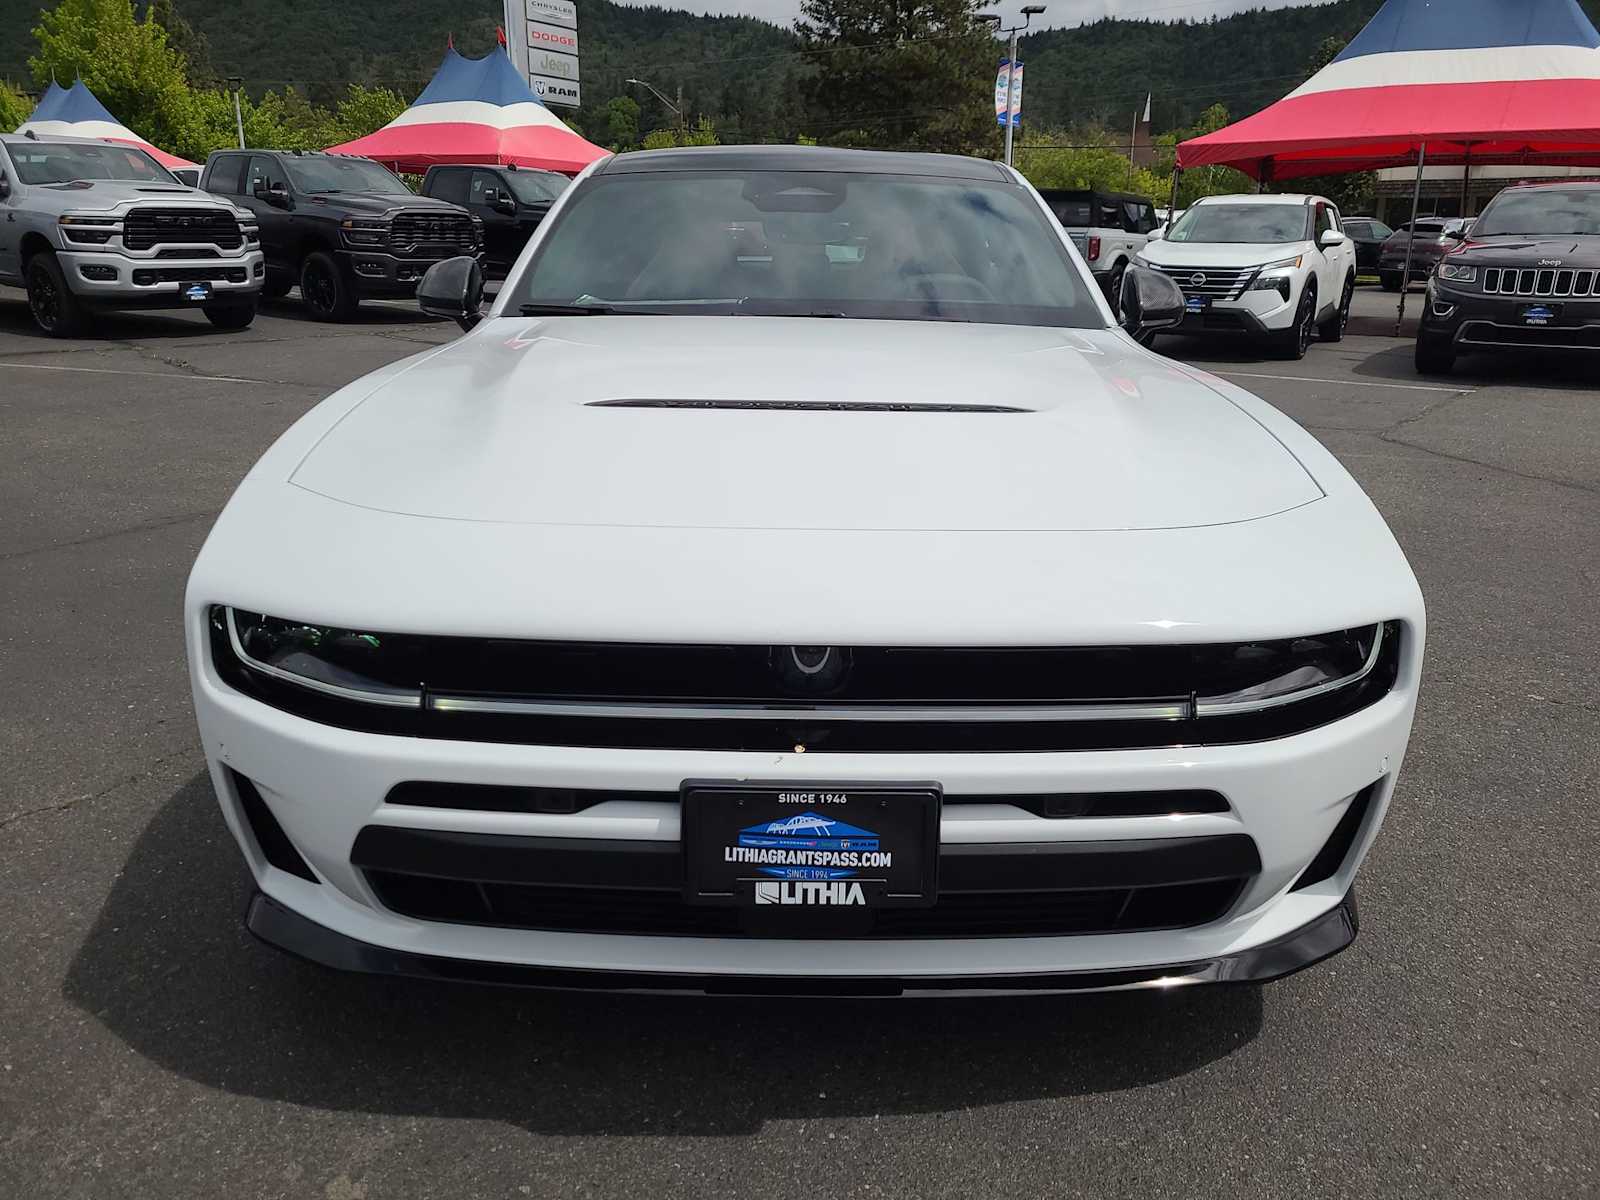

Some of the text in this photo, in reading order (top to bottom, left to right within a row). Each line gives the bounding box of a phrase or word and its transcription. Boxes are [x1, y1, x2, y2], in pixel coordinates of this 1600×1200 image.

[531, 1, 573, 14] CHRYSLER
[531, 31, 576, 46] DODGE
[540, 54, 570, 76] Jeep
[548, 86, 577, 97] RAM
[1537, 259, 1561, 267] Jeep
[778, 793, 847, 804] SINCE 1946
[724, 846, 892, 868] LITHIAGRANTSPASS.COM
[786, 869, 829, 879] SINCE 1994
[780, 882, 866, 905] LITHIA
